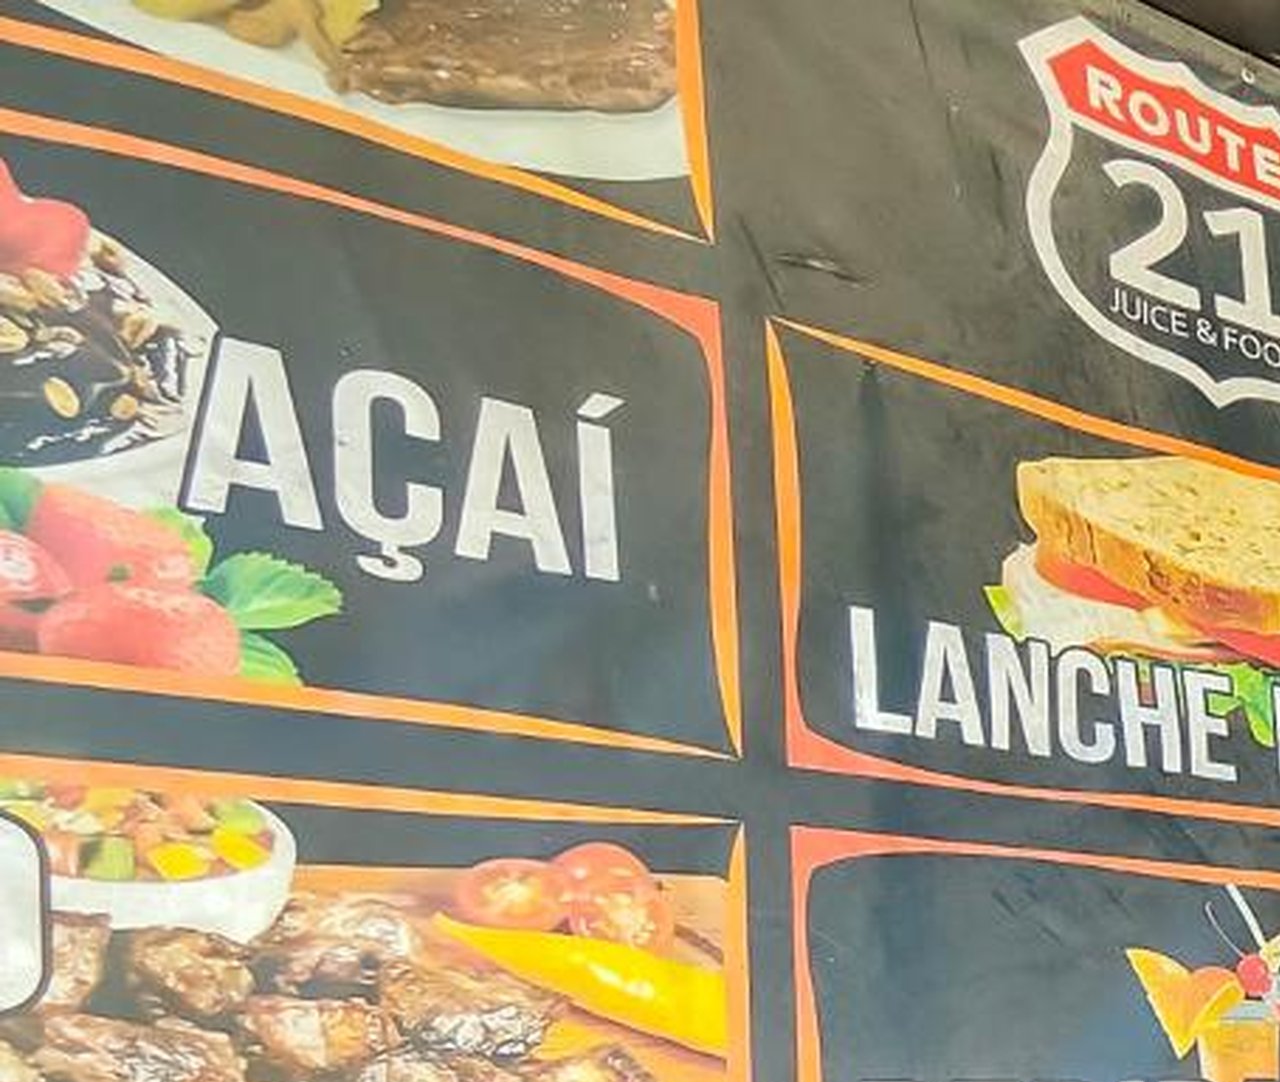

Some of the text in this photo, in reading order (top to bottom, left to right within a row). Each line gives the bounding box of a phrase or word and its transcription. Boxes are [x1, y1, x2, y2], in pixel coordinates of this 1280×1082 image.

[1110, 288, 1190, 338] JUICE
[1196, 318, 1218, 348] &
[185, 336, 625, 582] AÇAÍ
[848, 606, 1238, 782] LANCHE
